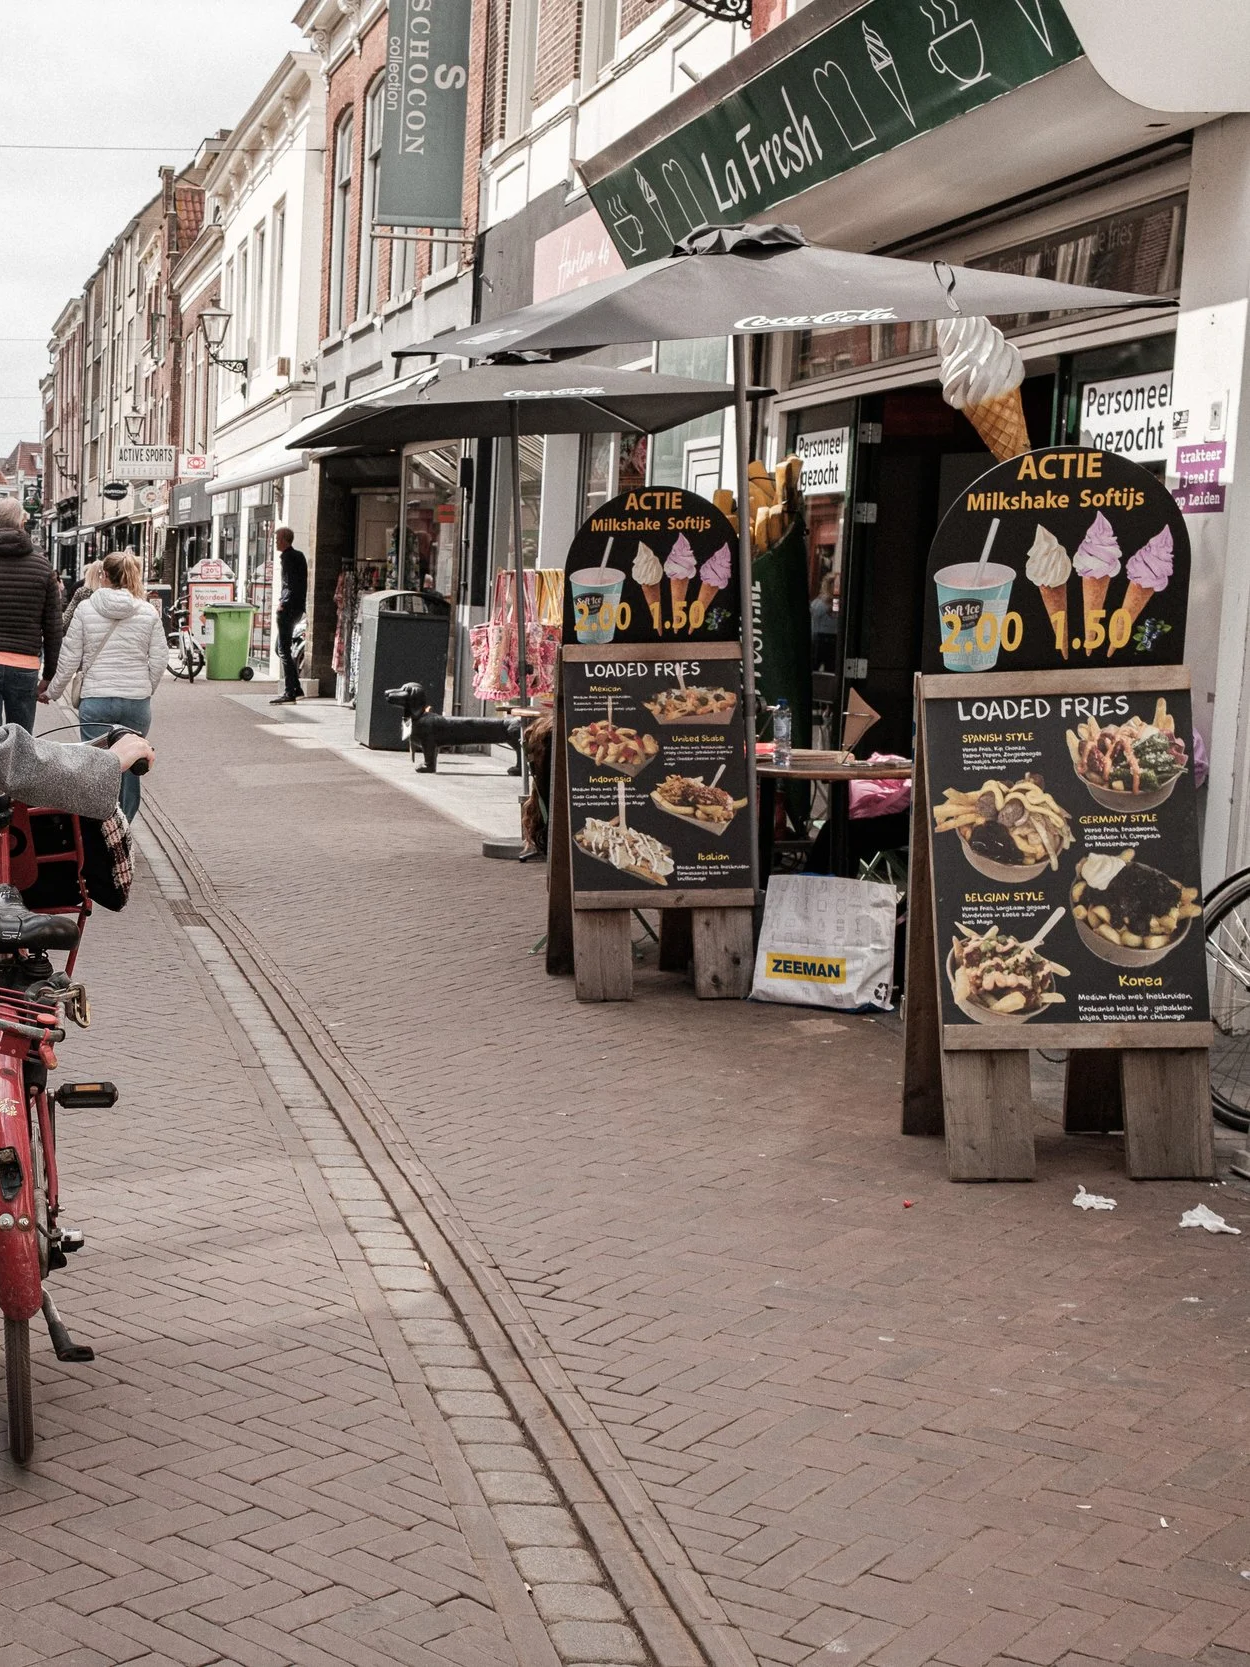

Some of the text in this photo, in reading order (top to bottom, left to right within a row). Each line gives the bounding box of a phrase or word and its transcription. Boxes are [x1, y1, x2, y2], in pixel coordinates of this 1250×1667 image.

[387, 36, 403, 111] collection
[434, 63, 467, 90] S
[701, 85, 823, 213] La Fresh
[734, 307, 899, 329] Coca-Cola
[503, 386, 606, 398] Coca-Cola
[1086, 373, 1174, 418] Personeel
[1093, 417, 1165, 453] gezocht
[798, 428, 845, 459] Personeel
[119, 448, 173, 462] ACTIVE SPORTS
[1180, 449, 1223, 463] trakteer
[1017, 452, 1103, 481] ACTIE
[800, 460, 839, 493] gezocht
[1183, 471, 1215, 488] jezelf
[624, 492, 683, 511] ACTIE
[967, 488, 1145, 512] Milkshake Softijs
[1188, 492, 1221, 506] Leiden
[591, 515, 711, 533] Milkshake Softijs
[574, 601, 705, 632] 2.00 1.50
[944, 604, 981, 617] Soft Ice
[939, 611, 1024, 653] 2.00
[1050, 608, 1133, 650] 1.50
[585, 662, 701, 678] LOADED FRIES
[958, 694, 1130, 722] LOADED FRIES
[962, 732, 1035, 744] SPANISH STYLE
[589, 776, 632, 784] Indonesia
[1079, 813, 1158, 824] GERMANY STYLE
[1084, 833, 1119, 841] Gebakken
[698, 852, 730, 861] Italian
[964, 891, 1045, 903] BELGIAN STYLE
[976, 918, 994, 926] Mayo
[771, 958, 840, 978] ZEEMAN
[1118, 974, 1163, 987] Korea
[1077, 993, 1108, 1001] Medium
[1078, 1005, 1115, 1013] Krokante
[1116, 1004, 1135, 1012] hete
[1136, 1004, 1149, 1013] kip
[1154, 1003, 1193, 1014] gebakken
[1102, 1012, 1137, 1022] bosuitjes
